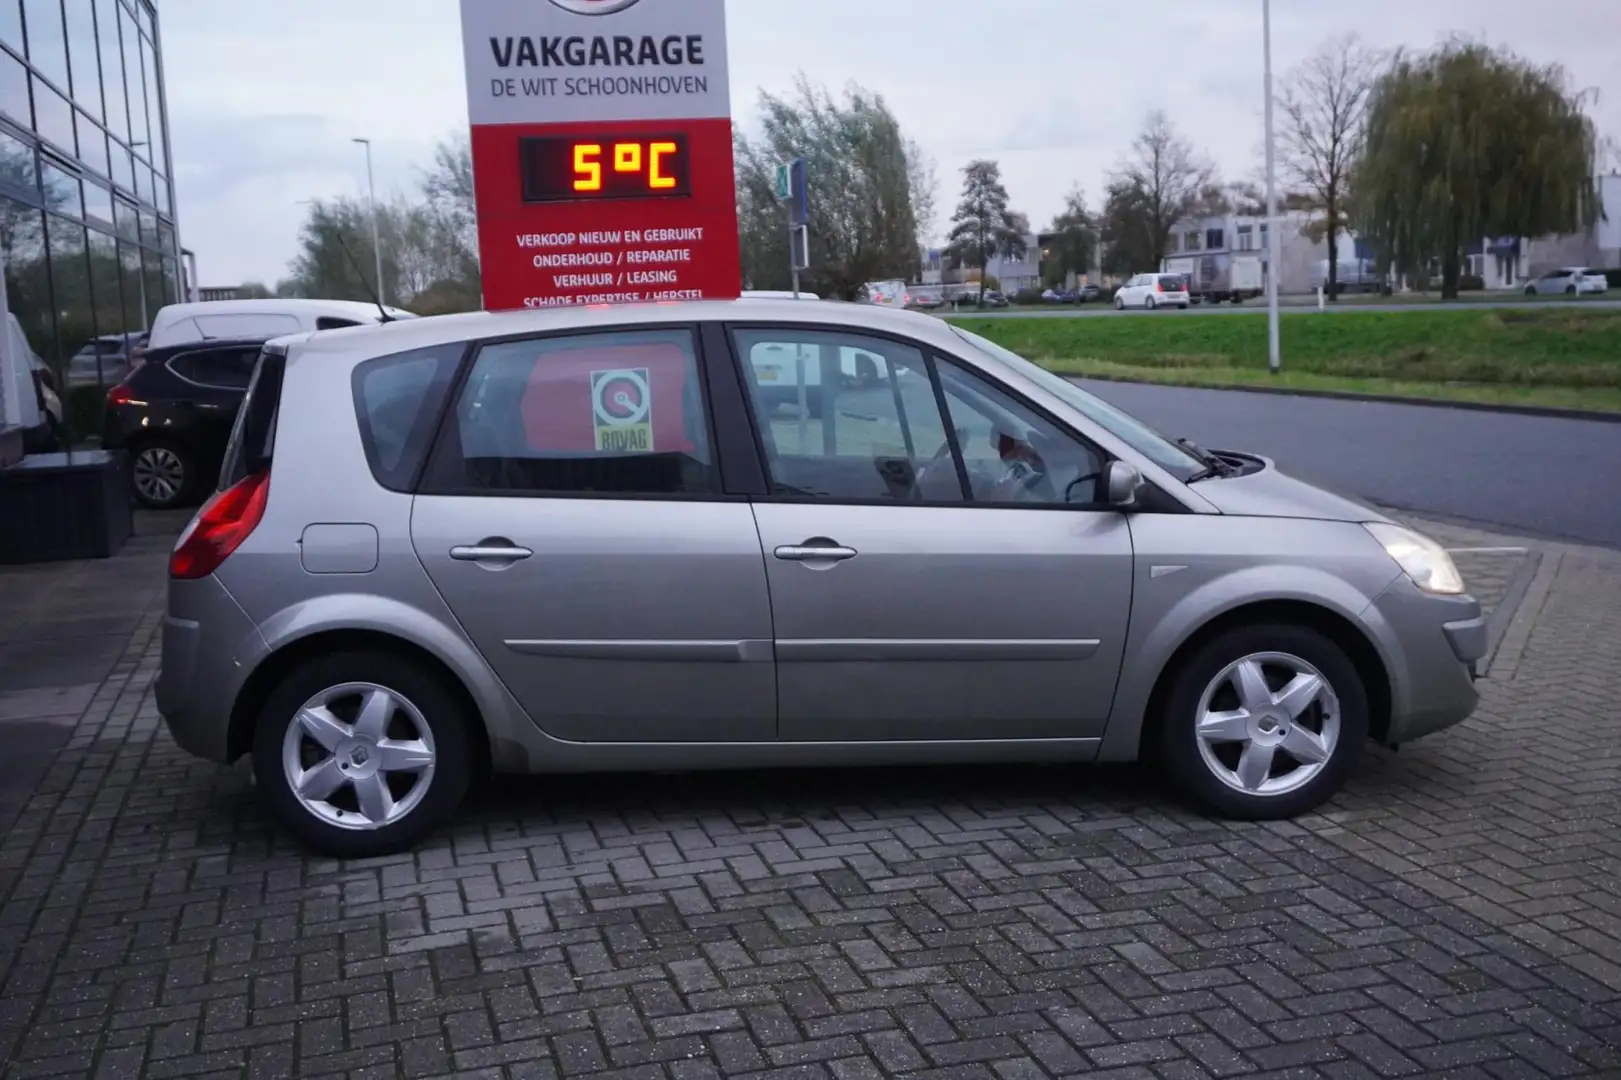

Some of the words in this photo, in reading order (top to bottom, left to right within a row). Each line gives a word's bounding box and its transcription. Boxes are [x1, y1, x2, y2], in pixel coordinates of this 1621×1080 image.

[489, 35, 705, 67] VAKGARAGE
[491, 79, 516, 97] DE
[521, 78, 558, 96] WIT
[564, 76, 708, 96] SCHOONHOVEN
[516, 232, 575, 247] VERKOOP
[578, 230, 621, 245] NIEUW
[624, 230, 641, 243] EN
[644, 227, 704, 243] GEBRUIKT
[533, 252, 613, 268] ONDERHOUD
[626, 248, 692, 264] REPARATIE
[553, 273, 613, 288] VERHUUR
[627, 270, 677, 285] LEASING
